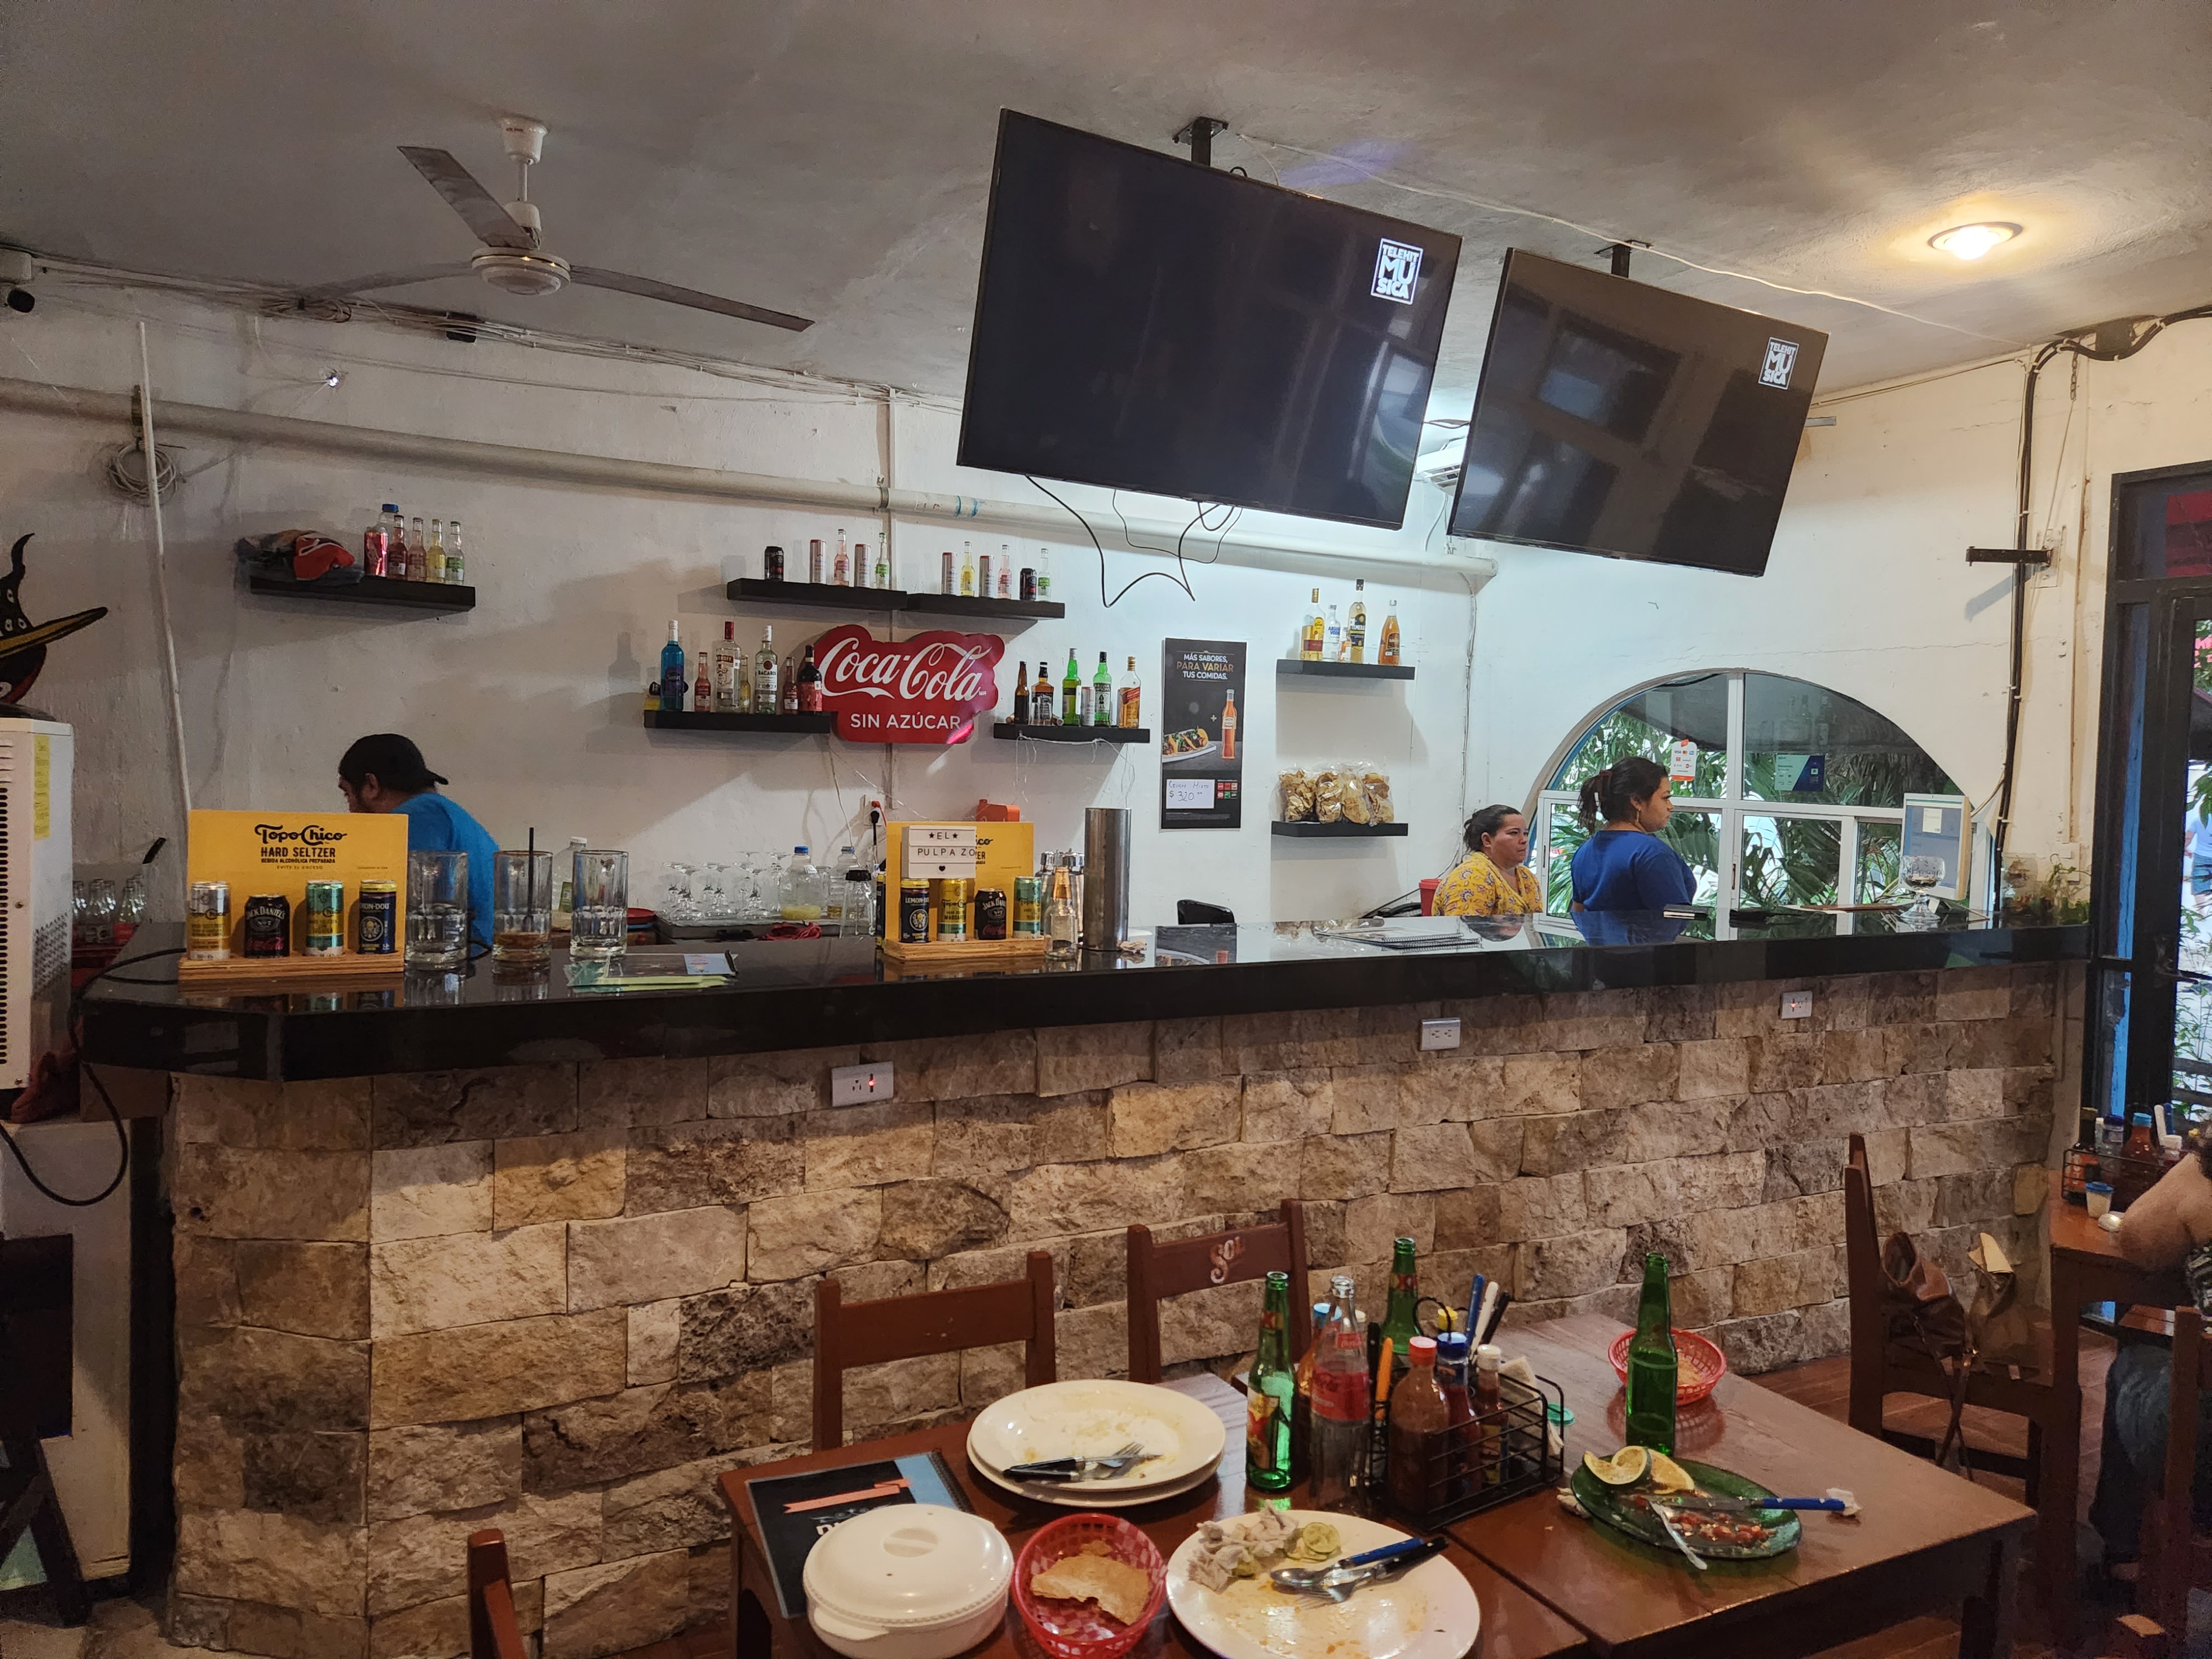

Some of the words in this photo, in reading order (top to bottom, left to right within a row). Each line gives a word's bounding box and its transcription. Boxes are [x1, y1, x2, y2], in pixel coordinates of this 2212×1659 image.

[1383, 244, 1420, 262] TELEHIT
[1770, 342, 1796, 356] TELEHIT
[1183, 653, 1198, 661] MÁS
[1198, 654, 1228, 663] SABORES,
[819, 637, 992, 701] Coca-Cola
[1177, 661, 1200, 670] PARA
[1202, 662, 1234, 672] VARIAR
[1197, 671, 1228, 680] COMIDAS.
[850, 713, 880, 728] SIN
[886, 711, 961, 729] AZÚCAR
[254, 823, 301, 844] Topo
[300, 825, 347, 846] Chico
[260, 847, 289, 858] HARD
[293, 847, 336, 858] SELTZER
